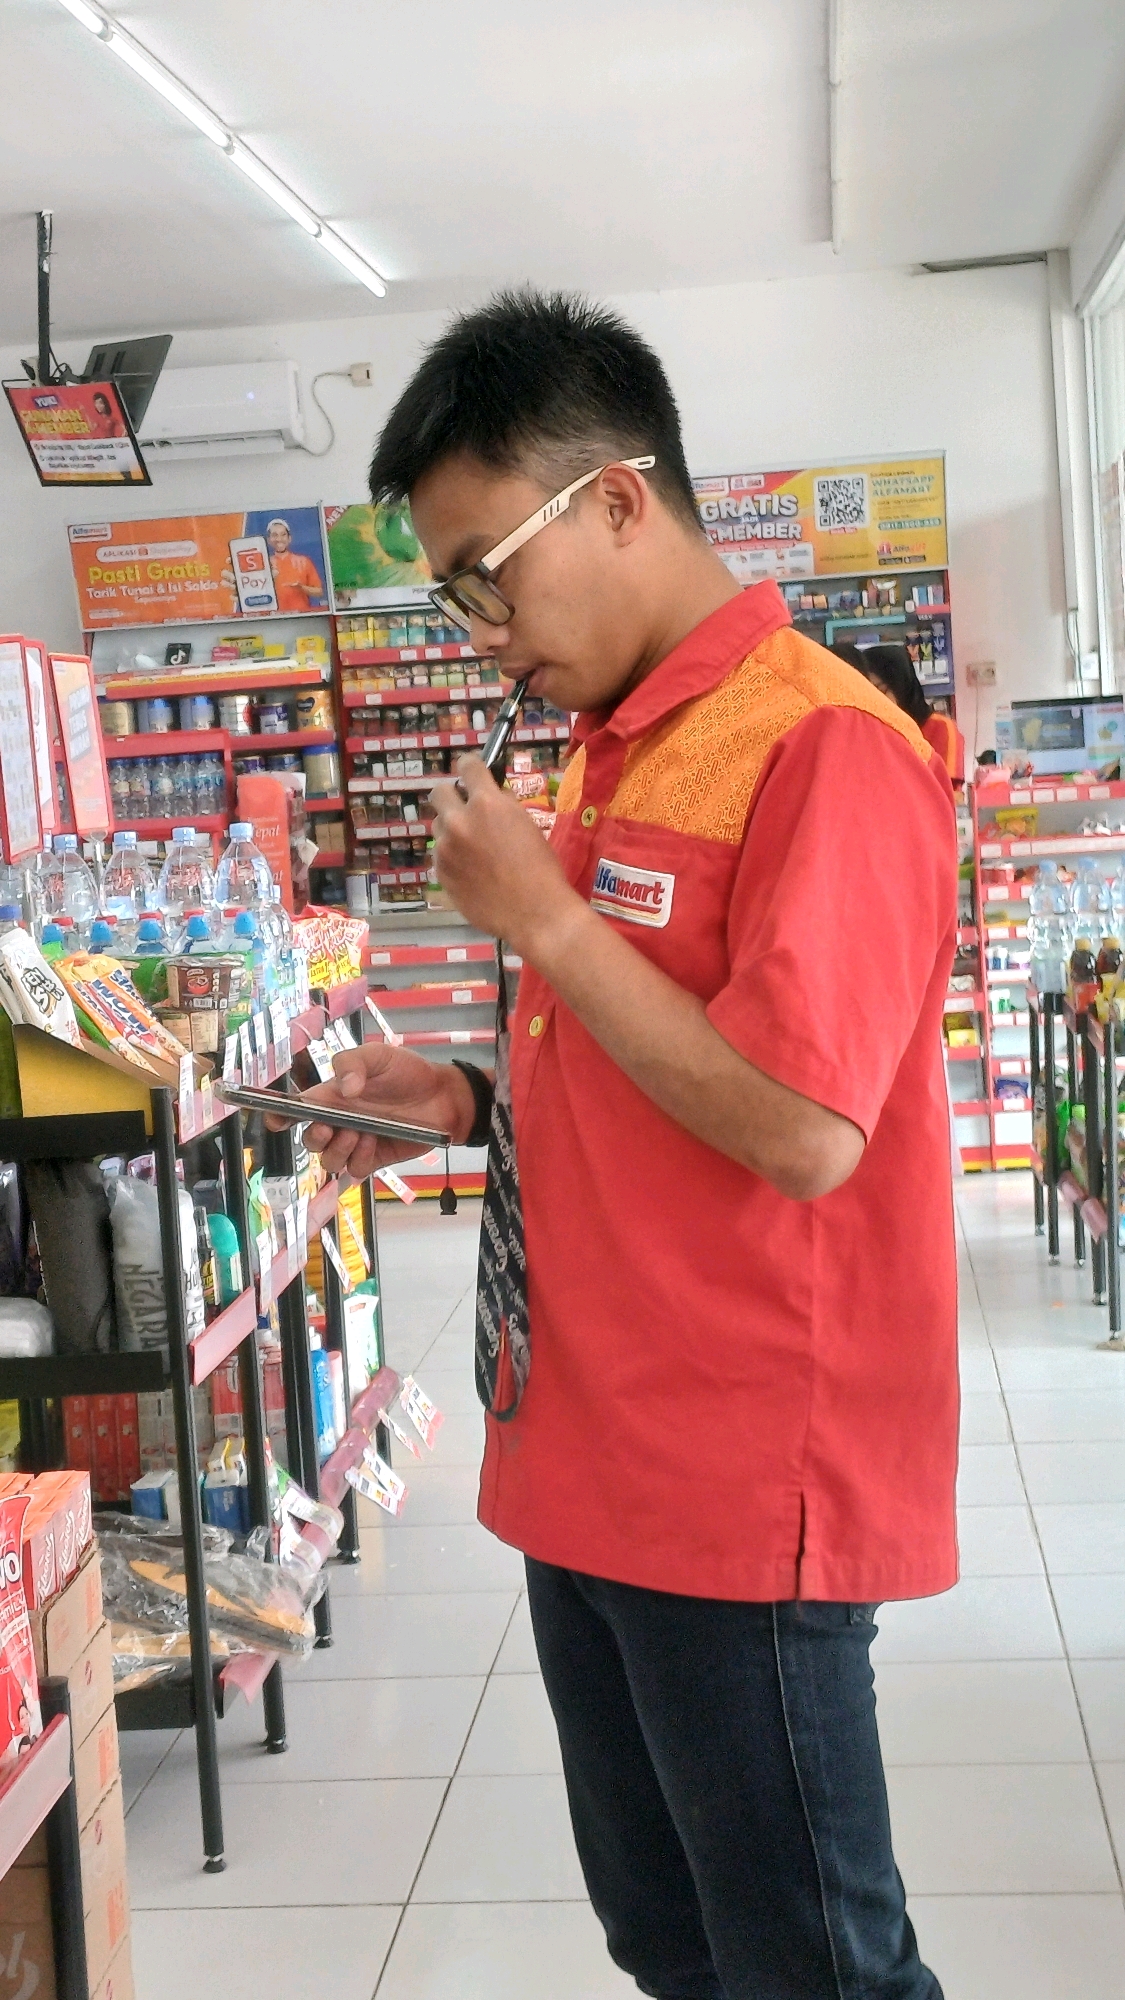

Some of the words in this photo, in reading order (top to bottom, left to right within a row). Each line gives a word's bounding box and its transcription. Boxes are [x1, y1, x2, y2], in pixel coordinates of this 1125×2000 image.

[872, 475, 935, 487] WHATSAPP
[873, 486, 931, 497] ALFAMART
[700, 494, 799, 524] GRATIS
[72, 527, 108, 536] Alfamart
[88, 564, 141, 585] Pasti
[147, 561, 211, 581] Gratis
[86, 586, 118, 600] Tarik
[120, 584, 154, 597] Tunai
[157, 582, 166, 595] &
[184, 579, 219, 593] Saldo
[240, 575, 267, 591] Pay
